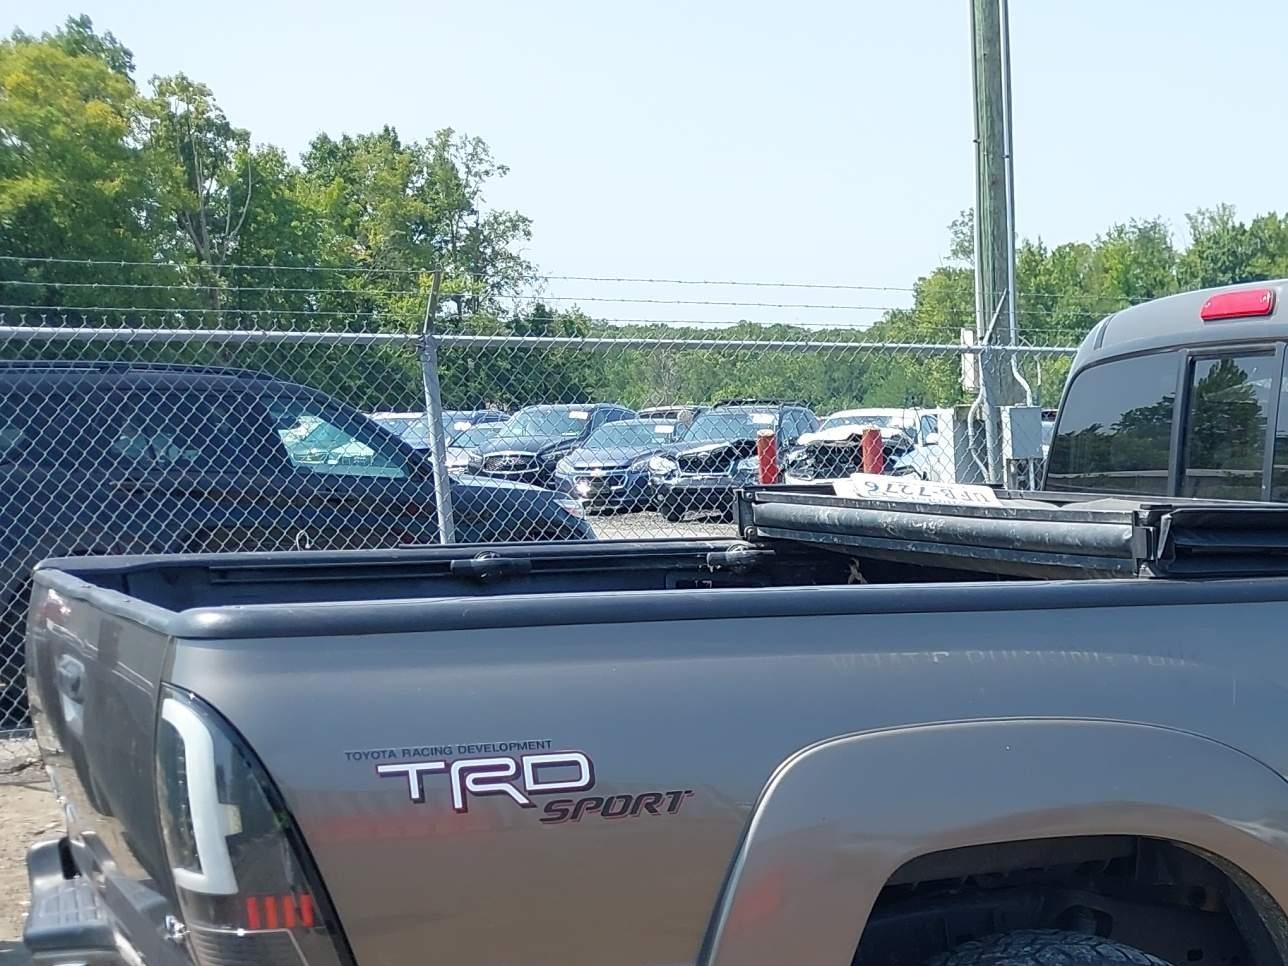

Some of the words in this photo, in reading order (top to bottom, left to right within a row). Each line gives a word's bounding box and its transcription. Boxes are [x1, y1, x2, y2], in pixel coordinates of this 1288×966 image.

[344, 751, 397, 761] TOYOTA
[402, 746, 453, 758] RACING
[457, 739, 553, 755] DEVELOPMENT
[377, 751, 597, 813] TRD
[539, 789, 696, 824] SPORT
